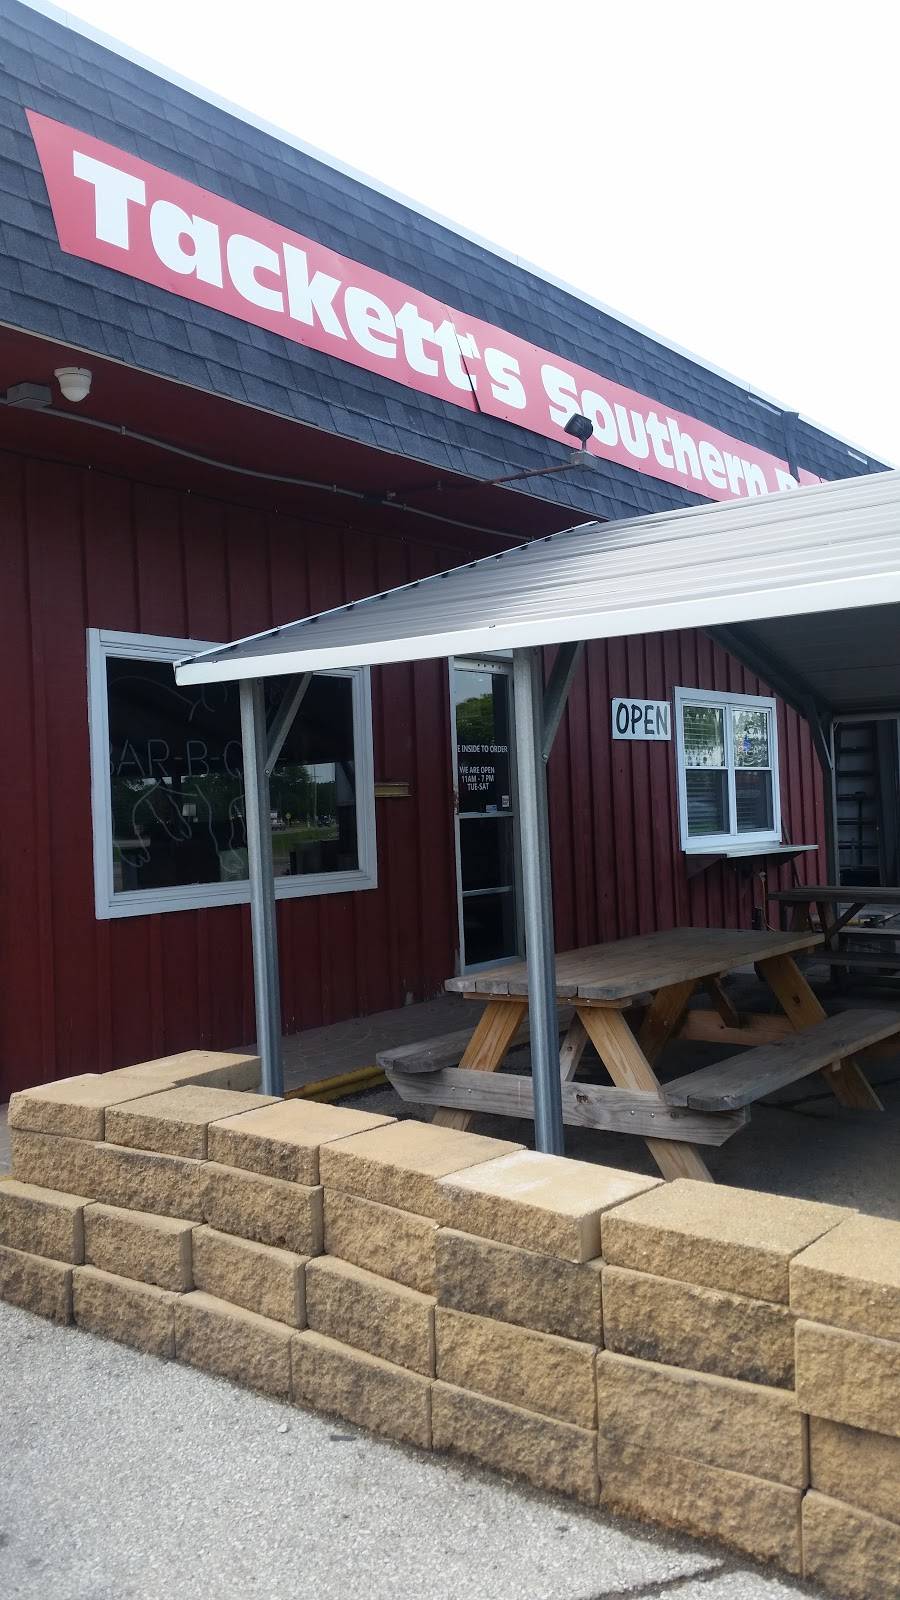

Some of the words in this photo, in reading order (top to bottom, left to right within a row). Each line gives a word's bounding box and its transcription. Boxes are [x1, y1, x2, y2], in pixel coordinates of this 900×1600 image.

[72, 149, 527, 409] Tackett's
[540, 364, 769, 497] Southern
[616, 702, 668, 735] OPEN
[461, 744, 480, 753] INSIDE
[481, 744, 489, 753] TO
[489, 745, 508, 753] ORDER
[461, 775, 477, 783] 11AM
[467, 782, 489, 790] TUE-SAT
